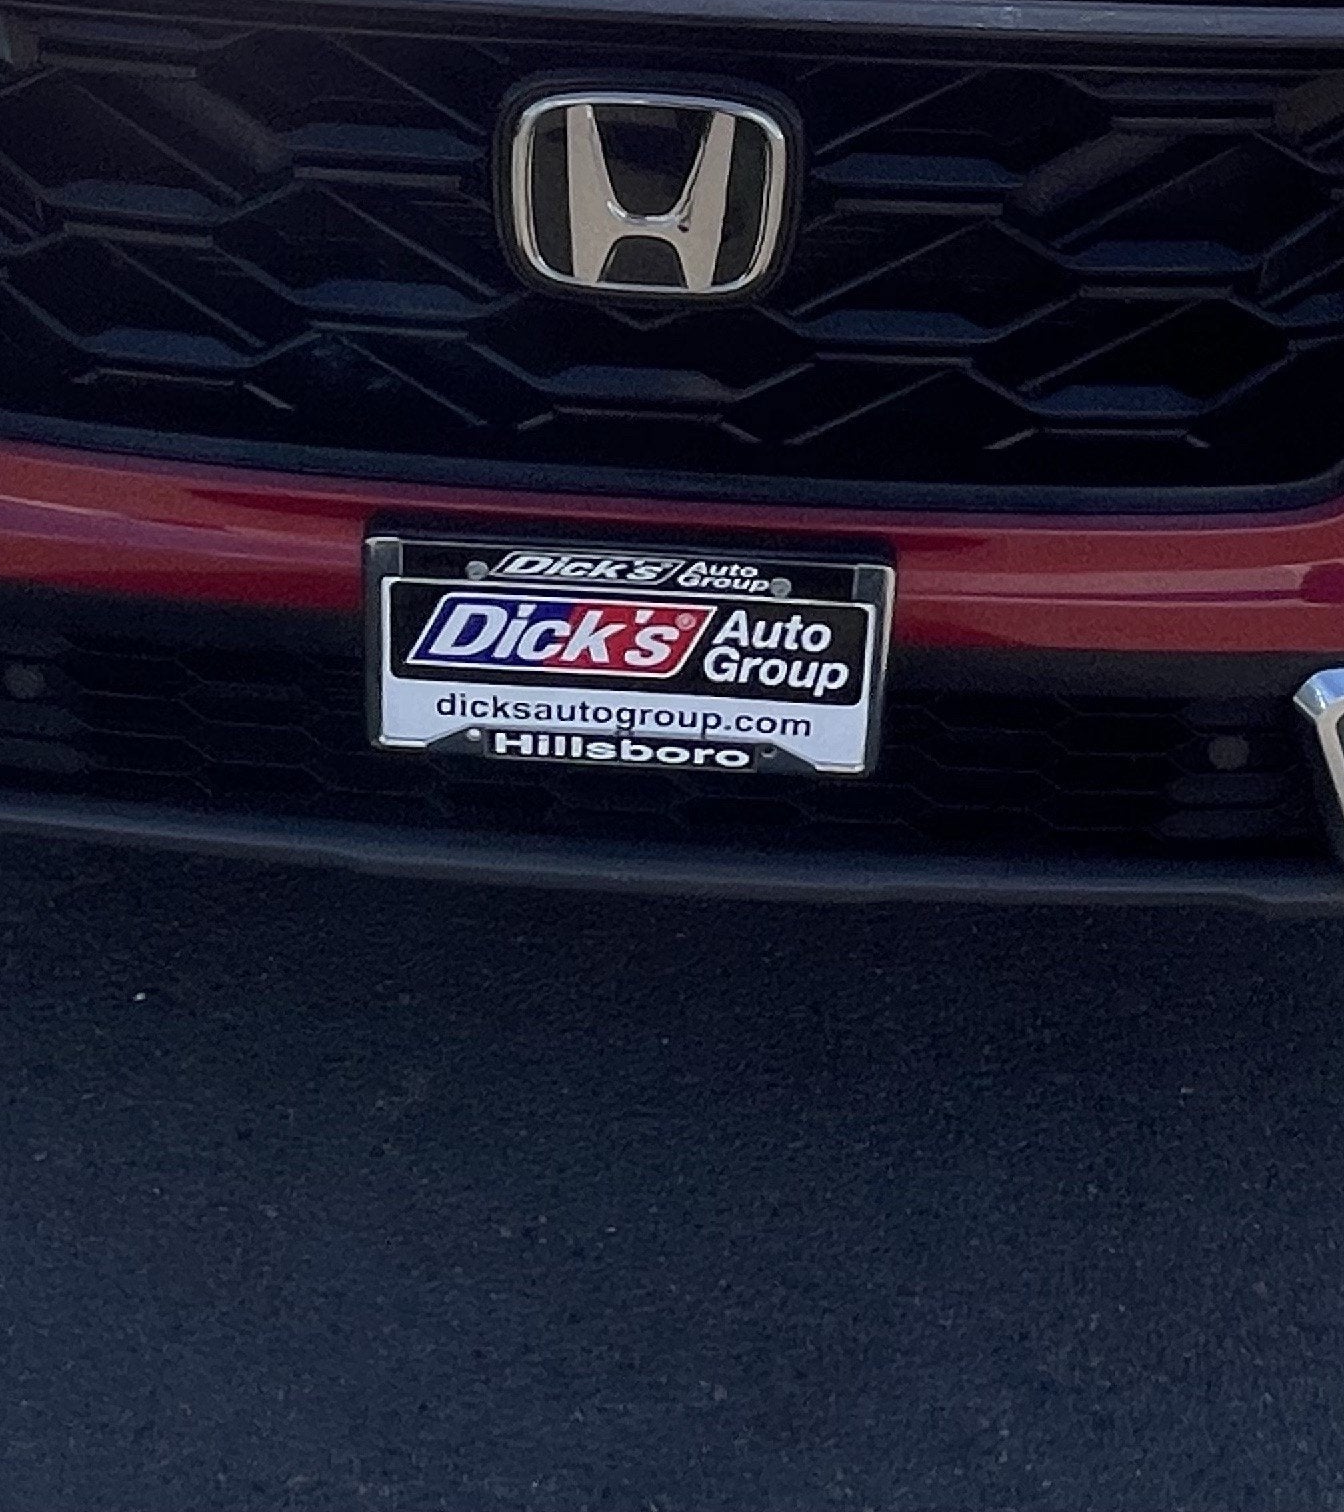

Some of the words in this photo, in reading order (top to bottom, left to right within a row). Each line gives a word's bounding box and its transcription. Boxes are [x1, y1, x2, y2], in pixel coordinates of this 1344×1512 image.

[676, 574, 771, 593] Group
[685, 561, 758, 578] Auto
[429, 603, 680, 668] Dick's
[713, 609, 832, 653] Auto
[703, 647, 850, 697] Group
[436, 693, 811, 737] dicksautogroup.com
[494, 732, 751, 768] Hillsboro
